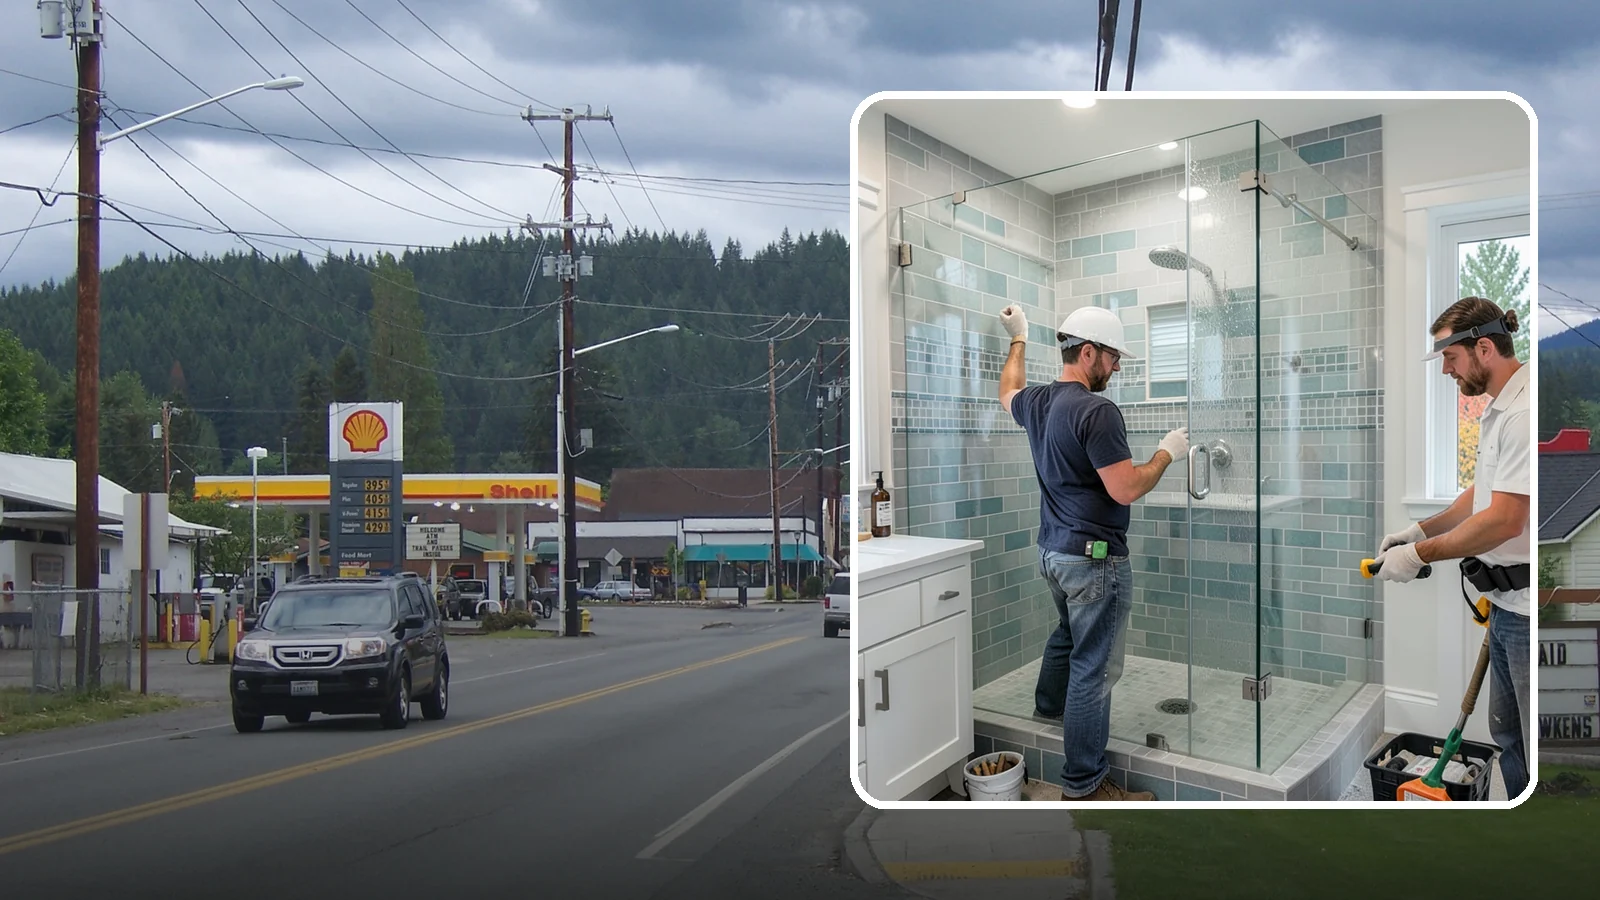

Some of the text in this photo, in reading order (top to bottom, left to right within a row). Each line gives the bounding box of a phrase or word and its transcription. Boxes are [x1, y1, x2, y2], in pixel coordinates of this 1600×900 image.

[366, 480, 384, 490] 395
[490, 484, 547, 499] Shell
[366, 494, 384, 504] 405
[366, 508, 383, 518] 415
[366, 522, 384, 533] 429
